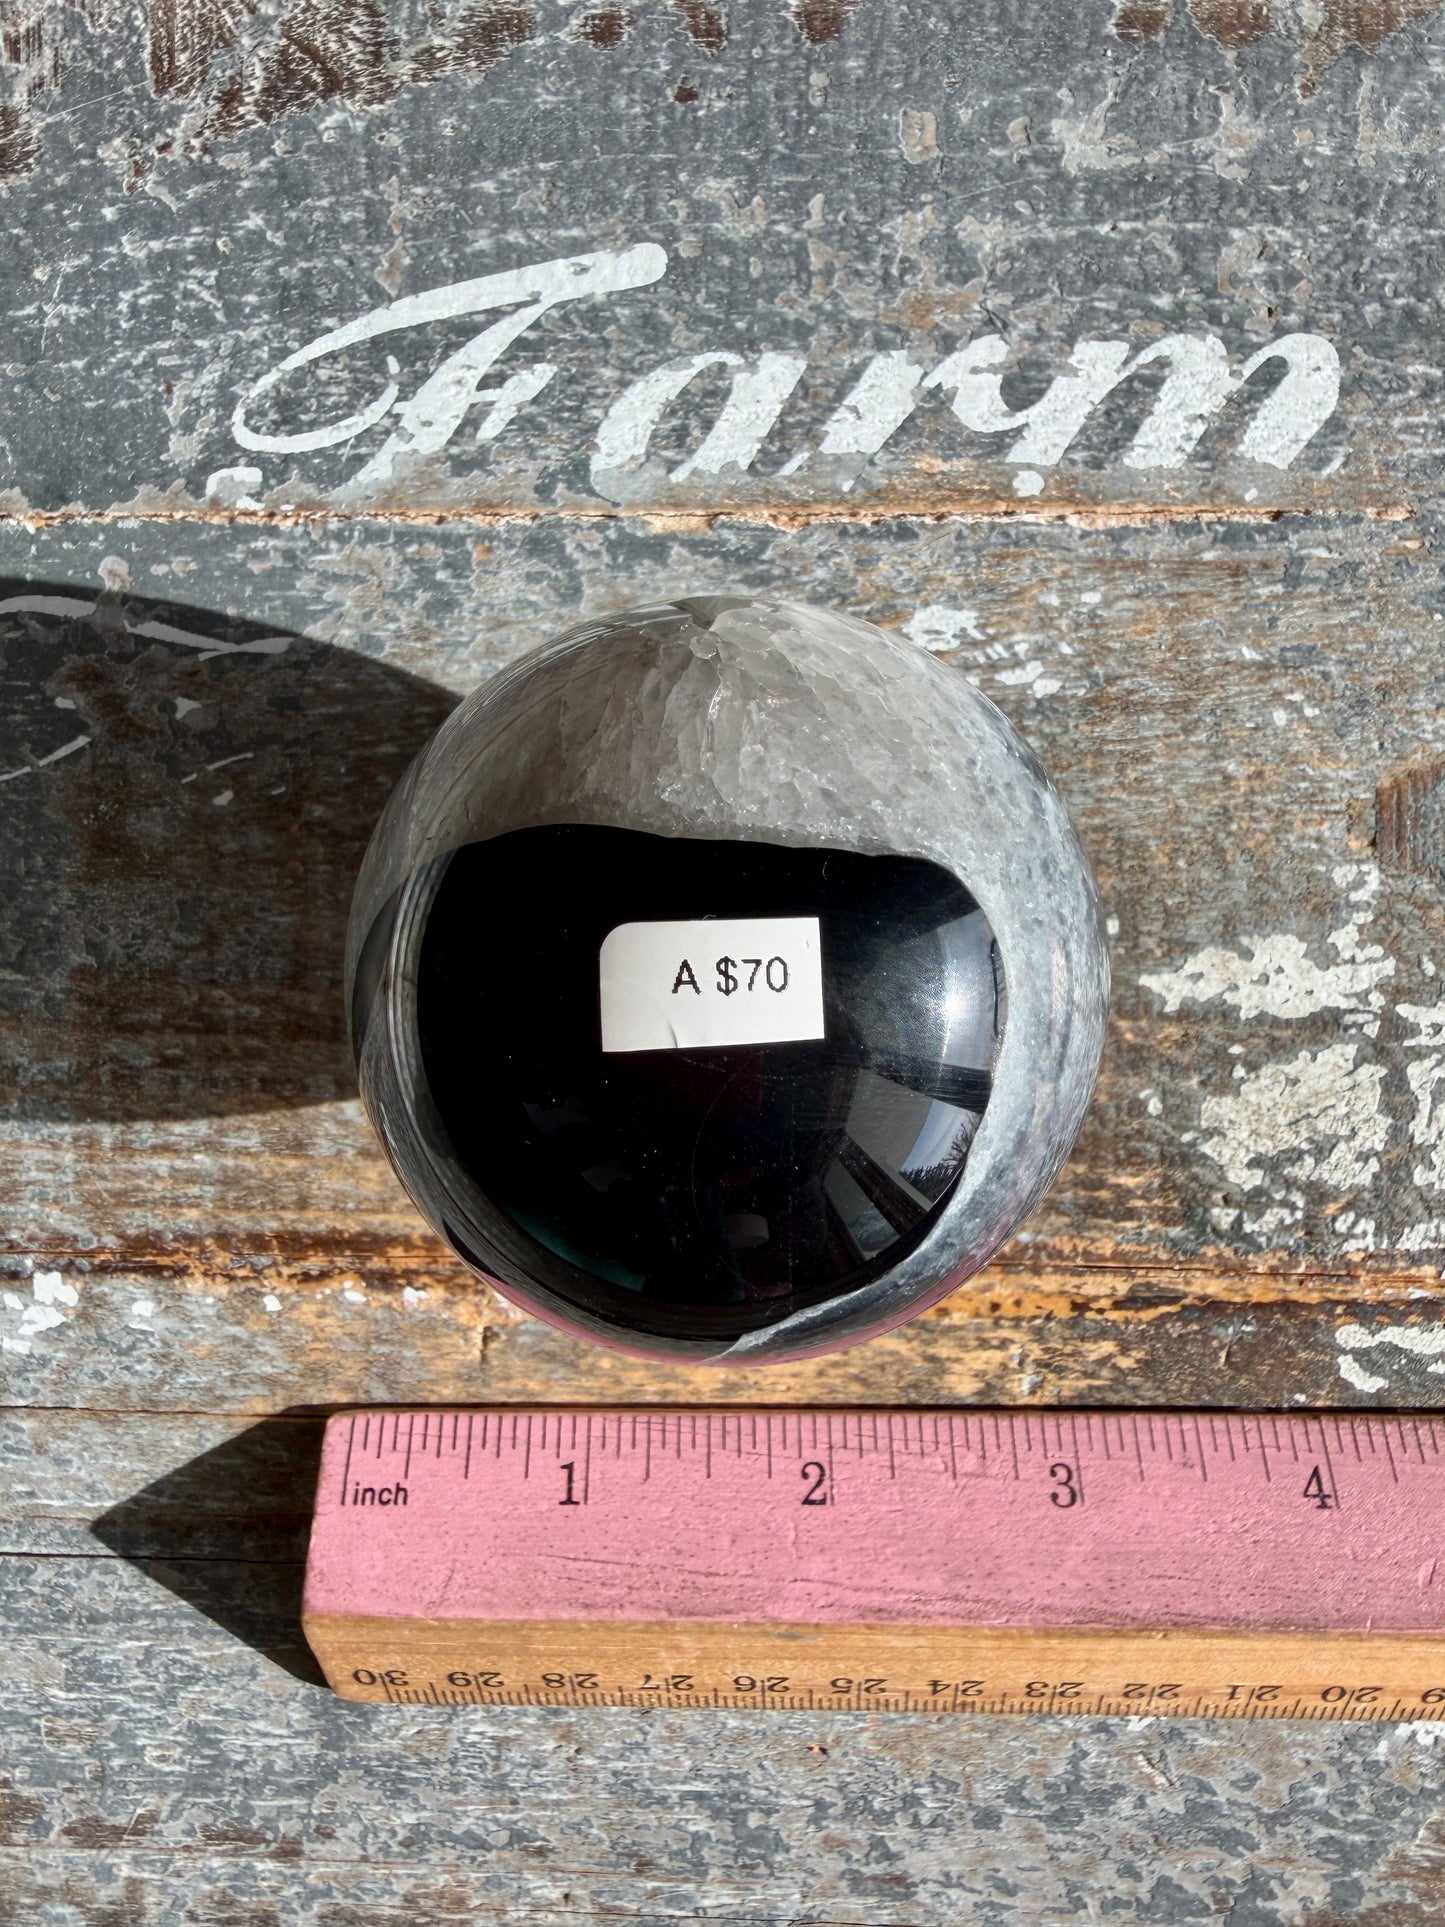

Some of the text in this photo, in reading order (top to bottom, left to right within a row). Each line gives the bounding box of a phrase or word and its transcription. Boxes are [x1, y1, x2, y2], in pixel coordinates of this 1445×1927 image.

[204, 241, 1349, 509] Farm
[671, 956, 789, 997] A $70
[352, 1461, 1332, 1510] inch 1 2 3 4
[352, 1669, 411, 1687] 30
[446, 1671, 504, 1689] 29
[541, 1672, 599, 1690] 28
[640, 1673, 695, 1692] 27
[734, 1676, 791, 1693] 26
[830, 1677, 887, 1695] 25
[927, 1679, 985, 1697] 24
[1025, 1681, 1085, 1698] 23
[1122, 1683, 1185, 1700] 22
[1227, 1685, 1283, 1702] 21
[1321, 1687, 1383, 1704] 20
